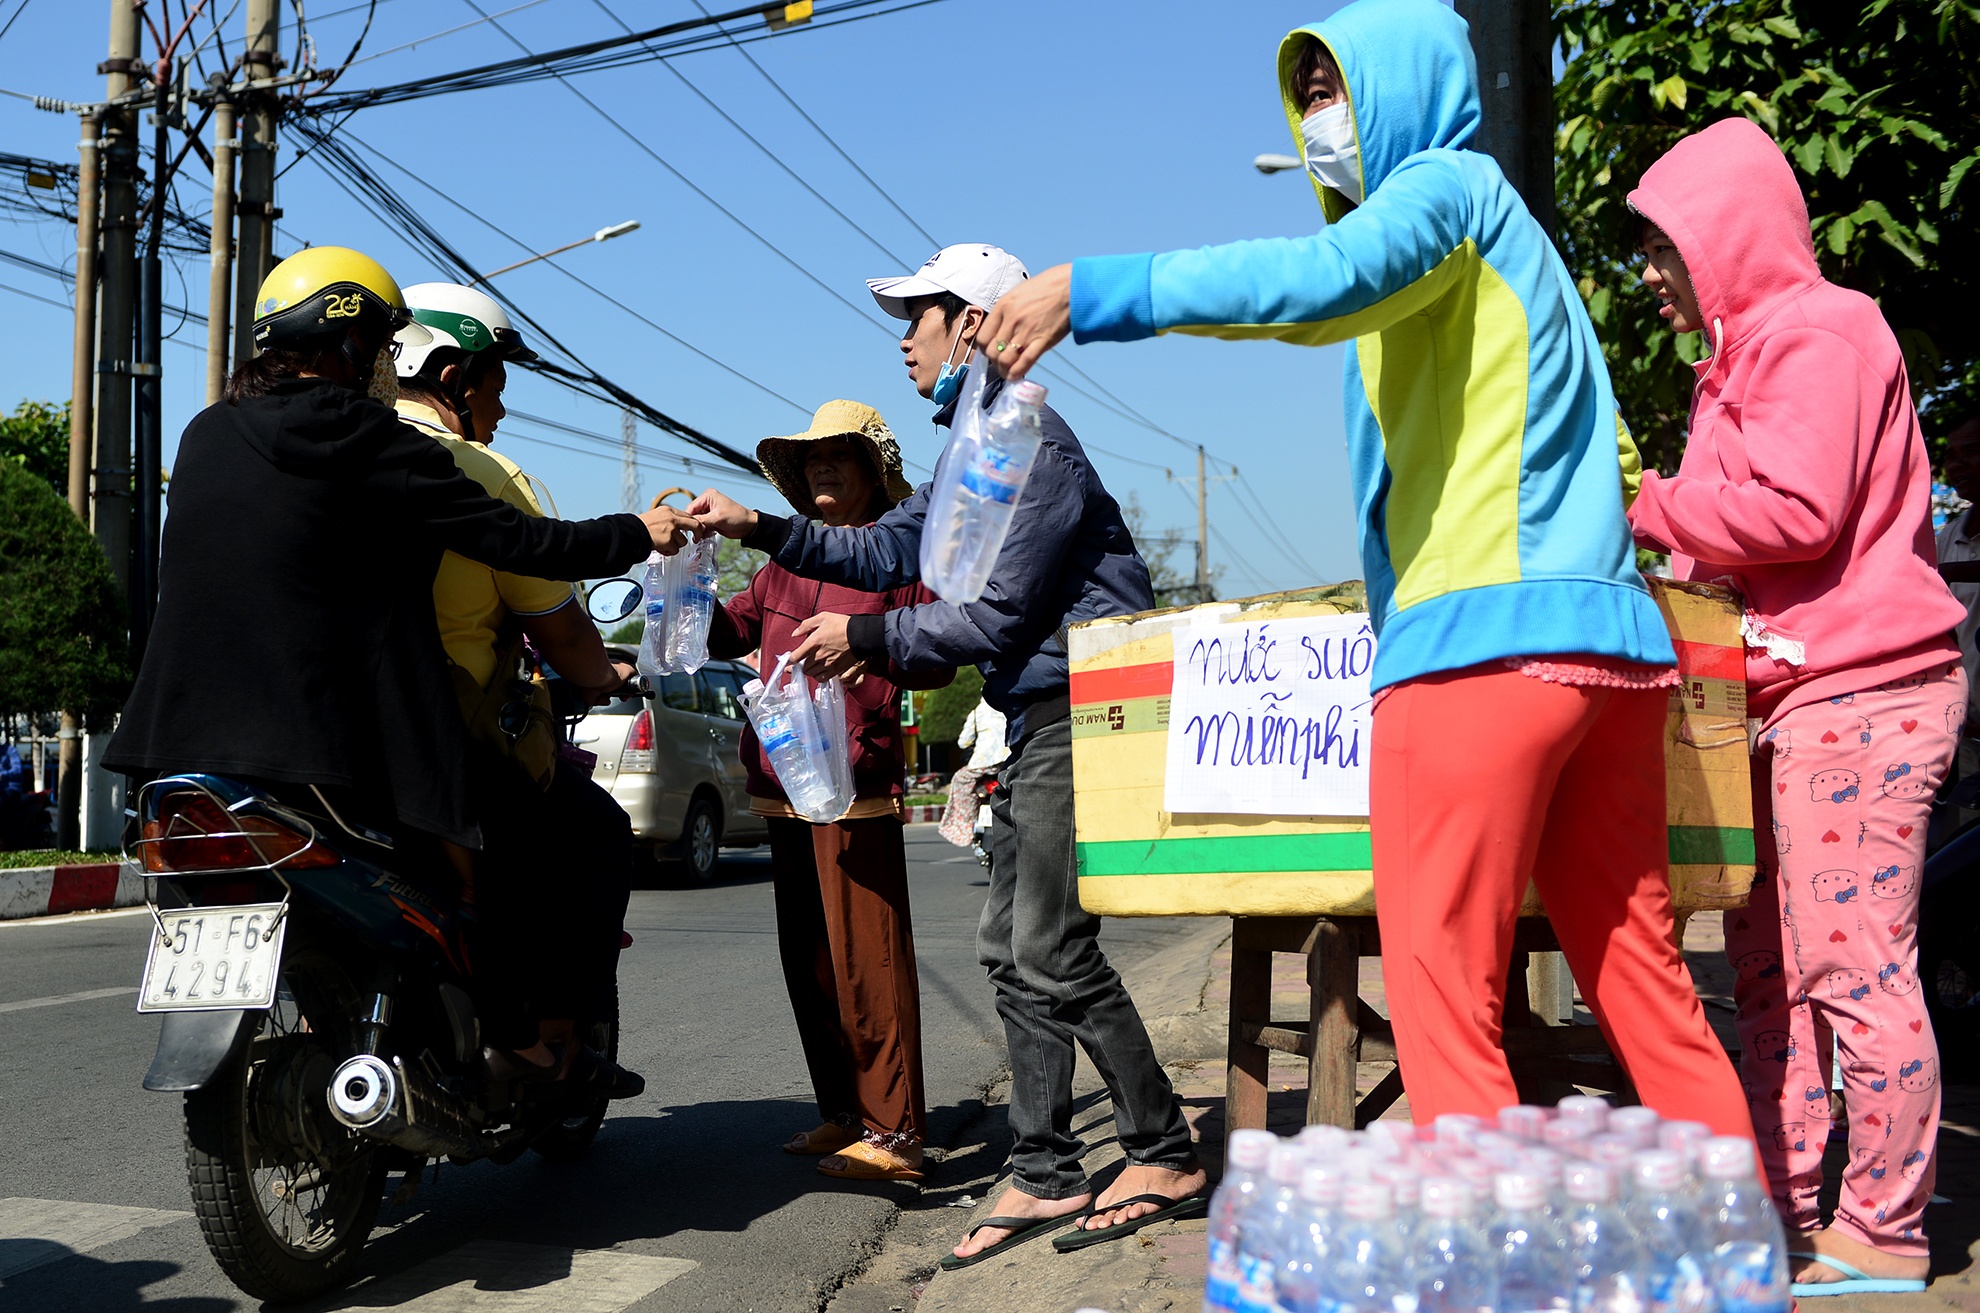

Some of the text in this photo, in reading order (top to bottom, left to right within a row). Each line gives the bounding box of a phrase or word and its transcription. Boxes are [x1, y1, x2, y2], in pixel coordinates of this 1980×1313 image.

[1298, 618, 1373, 681] suô
[1086, 713, 1107, 725] NAM
[172, 914, 263, 955] 51 F6
[163, 960, 252, 999] 4294
